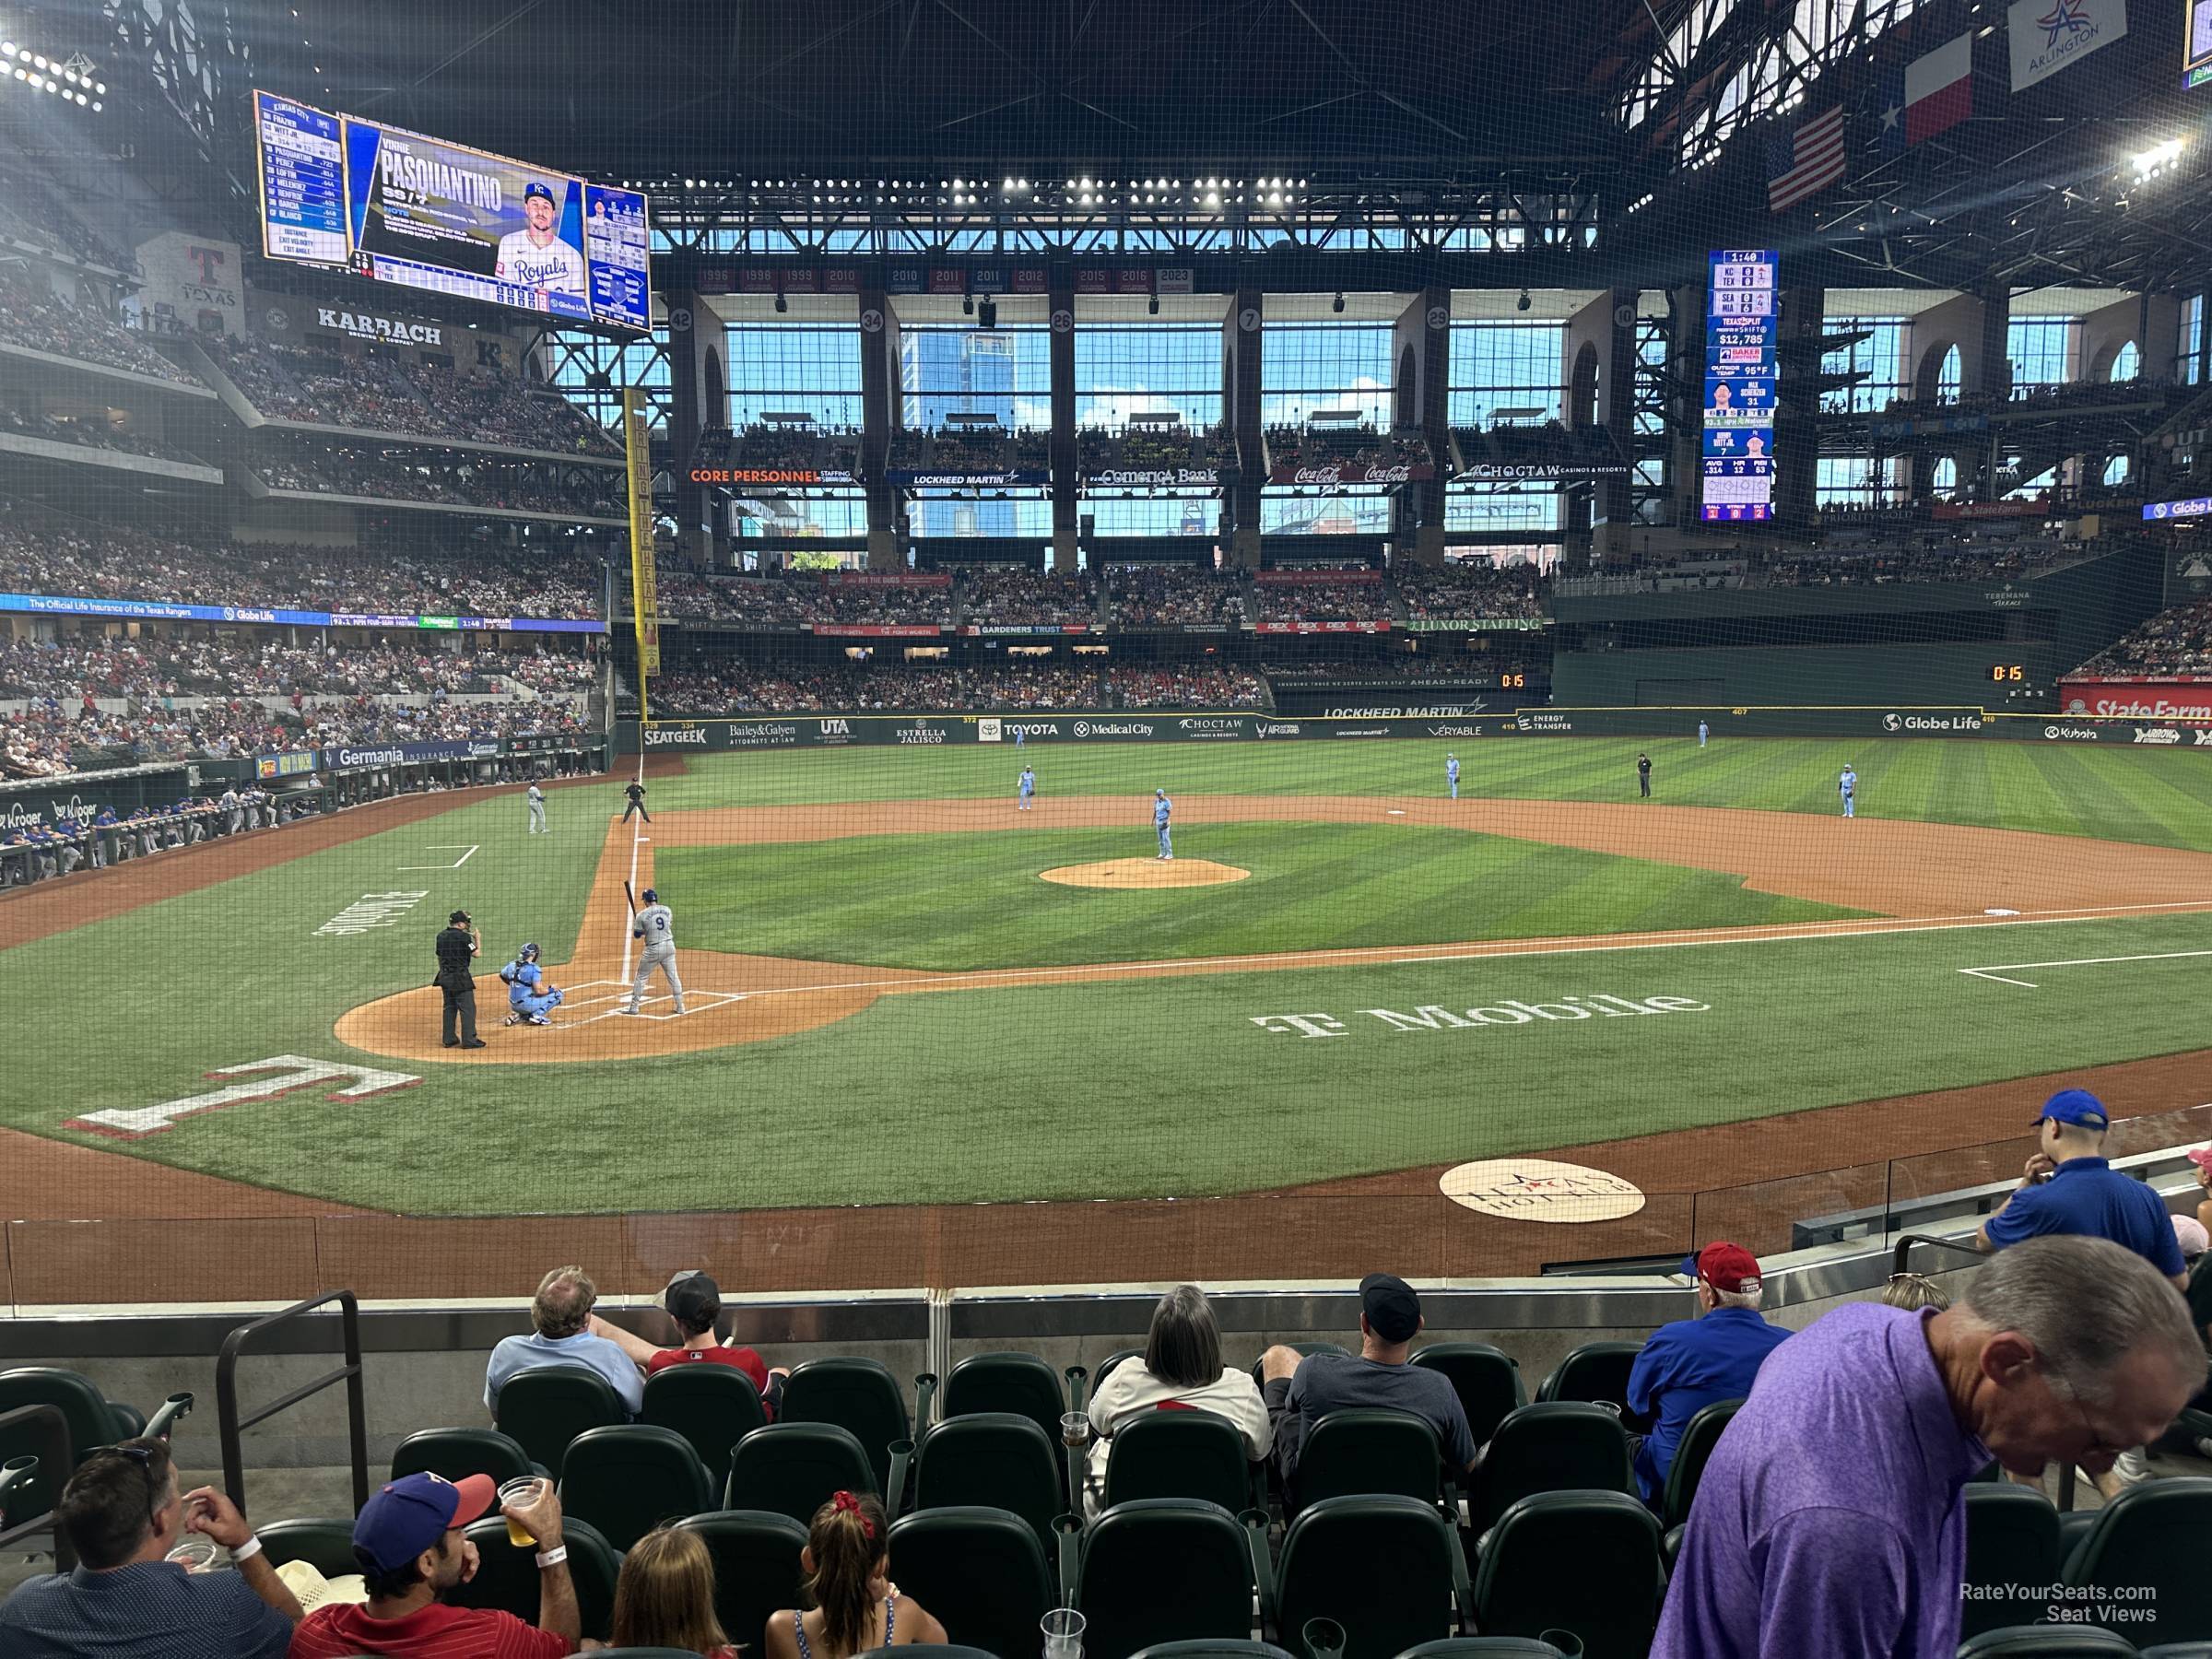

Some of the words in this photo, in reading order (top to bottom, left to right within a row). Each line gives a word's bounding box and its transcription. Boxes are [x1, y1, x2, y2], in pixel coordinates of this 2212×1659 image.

[2029, 24, 2100, 73] ARLINGTON
[297, 109, 310, 122] CITY
[382, 138, 411, 154] VINNIE
[275, 157, 295, 168] PEREZ
[276, 167, 298, 180] LOFTIN
[381, 149, 502, 212] PASQUANTINO
[382, 186, 406, 200] SS
[383, 206, 409, 218] NOTE
[1732, 253, 1757, 262] 1:40
[514, 257, 568, 287] Royals
[892, 270, 917, 281] 2010
[936, 270, 959, 281] 2011
[977, 270, 999, 281] 2011
[1018, 270, 1043, 281] 2012
[1080, 270, 1105, 281] 2015
[1122, 270, 1147, 281] 2016
[1161, 270, 1188, 281] 2023
[1724, 277, 1735, 286] TEX
[182, 286, 236, 306] TEXAS
[1723, 294, 1734, 302] SEA
[559, 301, 575, 311] Globe
[576, 304, 587, 312] Life
[1723, 304, 1734, 312] MIA
[672, 313, 690, 326] 42
[864, 314, 882, 326] 34
[1053, 314, 1070, 327] 26
[1246, 312, 1254, 327] 7
[1430, 312, 1446, 323] 29
[1619, 311, 1630, 322] 10
[318, 308, 441, 346] KARBACH
[349, 331, 376, 340] BREWING
[1719, 335, 1763, 346] $12,785
[1745, 366, 1768, 375] 95°F
[636, 417, 647, 490] BRING
[691, 470, 729, 482] CORE
[734, 470, 819, 482] PERSONNEL
[1178, 468, 1218, 483] Bank
[1479, 465, 1559, 477] CHOCTAW
[914, 476, 964, 484] LOCKHEED
[967, 476, 1004, 484] MARTIN
[2172, 500, 2206, 513] Globe
[1824, 511, 1876, 523] PRIORITY
[1878, 509, 1913, 520] GOLD
[642, 555, 653, 612] HEAT
[29, 599, 44, 608] The
[47, 600, 73, 609] Official
[76, 602, 88, 610] Life
[90, 603, 123, 613] Insurance
[125, 604, 133, 612] of
[134, 604, 145, 613] the
[147, 606, 164, 615] Texas
[166, 607, 192, 617] Rangers
[237, 610, 259, 619] Globe
[260, 611, 275, 620] Life
[1421, 619, 1469, 631] LUXOR
[1473, 618, 1539, 630] STAFFING
[1994, 666, 2021, 680] 0:15
[1502, 675, 1524, 687] 0:15
[1324, 707, 1403, 719] LOCKHEED
[1405, 706, 1464, 717] MARTIN
[820, 720, 849, 734] UTA
[1185, 719, 1242, 729] CHOCTAW
[1906, 716, 1949, 729] Globe
[1952, 715, 1981, 729] Life
[730, 724, 795, 737] Bailey&Galyen
[1004, 724, 1058, 735] TOYOTA
[1091, 724, 1131, 735] Medical
[1132, 724, 1154, 736] City
[1267, 725, 1280, 734] AIR
[2061, 728, 2097, 738] Kubota
[645, 728, 706, 745] SEATGEEK
[340, 746, 404, 766] Germania
[406, 749, 454, 760] INSURANCE
[7, 802, 41, 828] Kroger
[655, 916, 665, 930] 9
[1249, 1013, 1349, 1038] T
[1355, 994, 1711, 1031] Mobile
